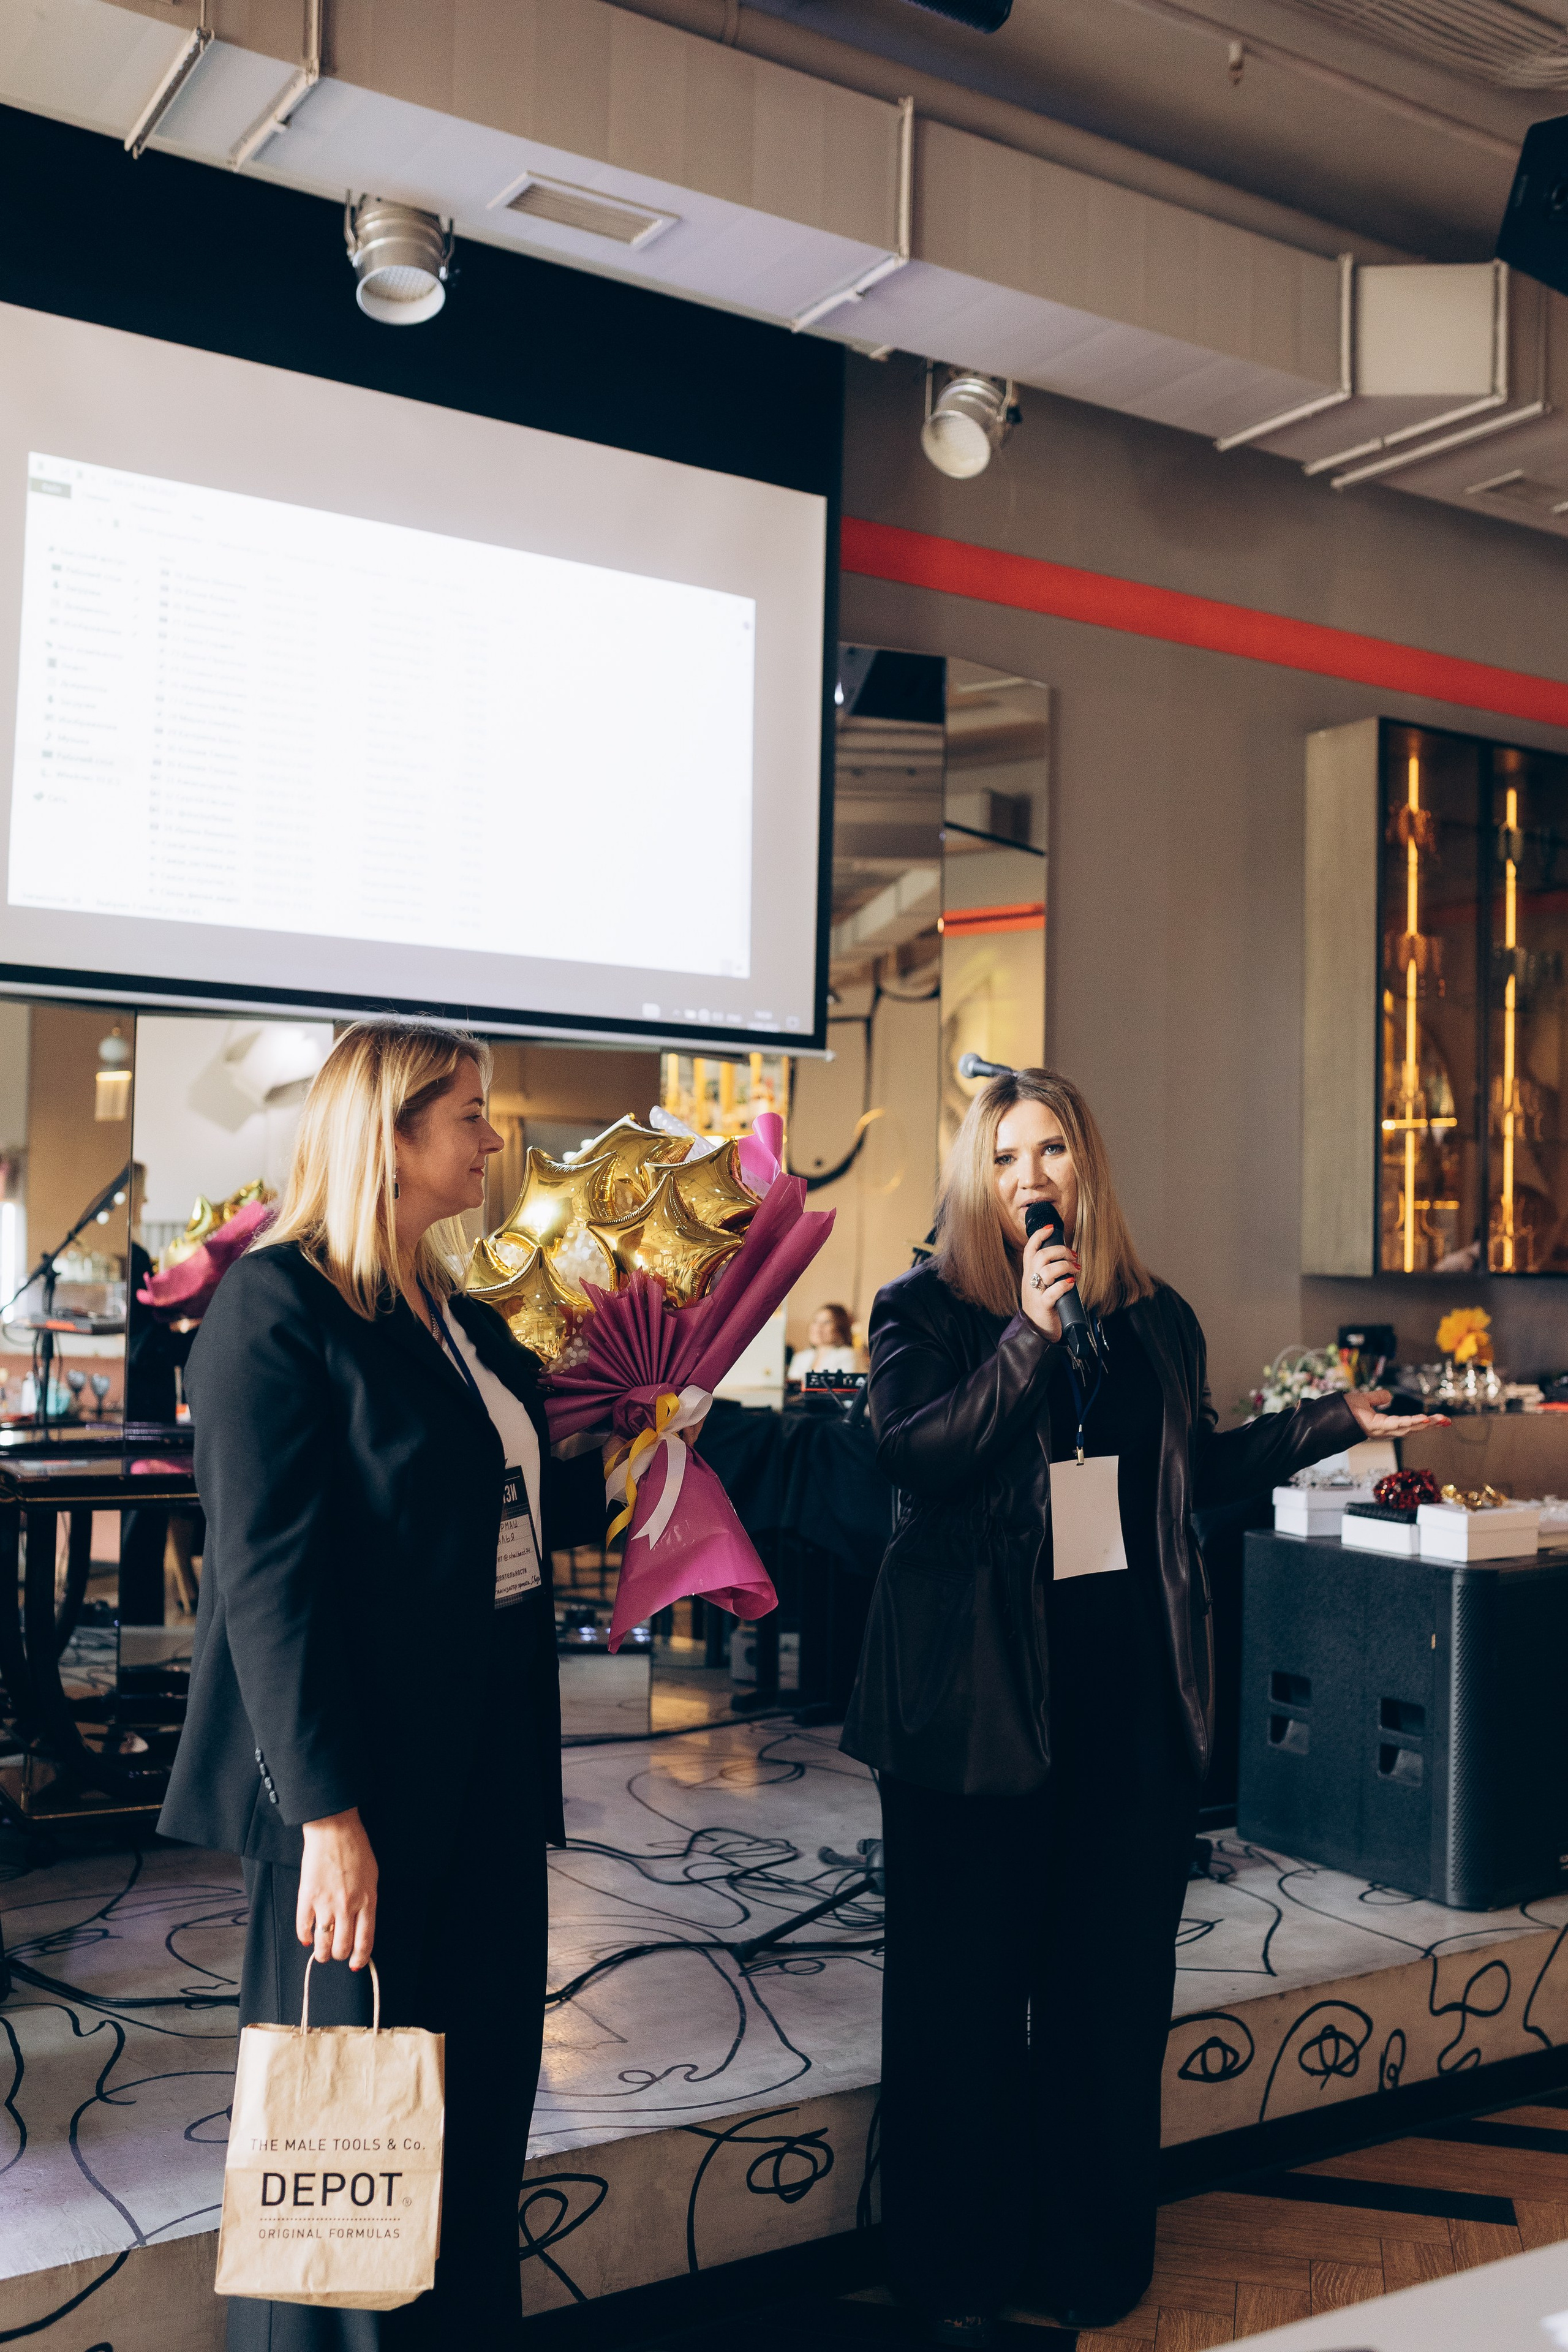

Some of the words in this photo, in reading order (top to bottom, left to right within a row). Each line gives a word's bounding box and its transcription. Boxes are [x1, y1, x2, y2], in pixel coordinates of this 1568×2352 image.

[251, 2138, 279, 2151] THE
[285, 2138, 326, 2151] MALE
[334, 2138, 380, 2150] TOOLS
[387, 2138, 396, 2150] &
[404, 2138, 426, 2150] Co.
[261, 2172, 403, 2207] DEPOT
[258, 2228, 322, 2239] ORIGINAL
[329, 2228, 400, 2239] FORMULAS
